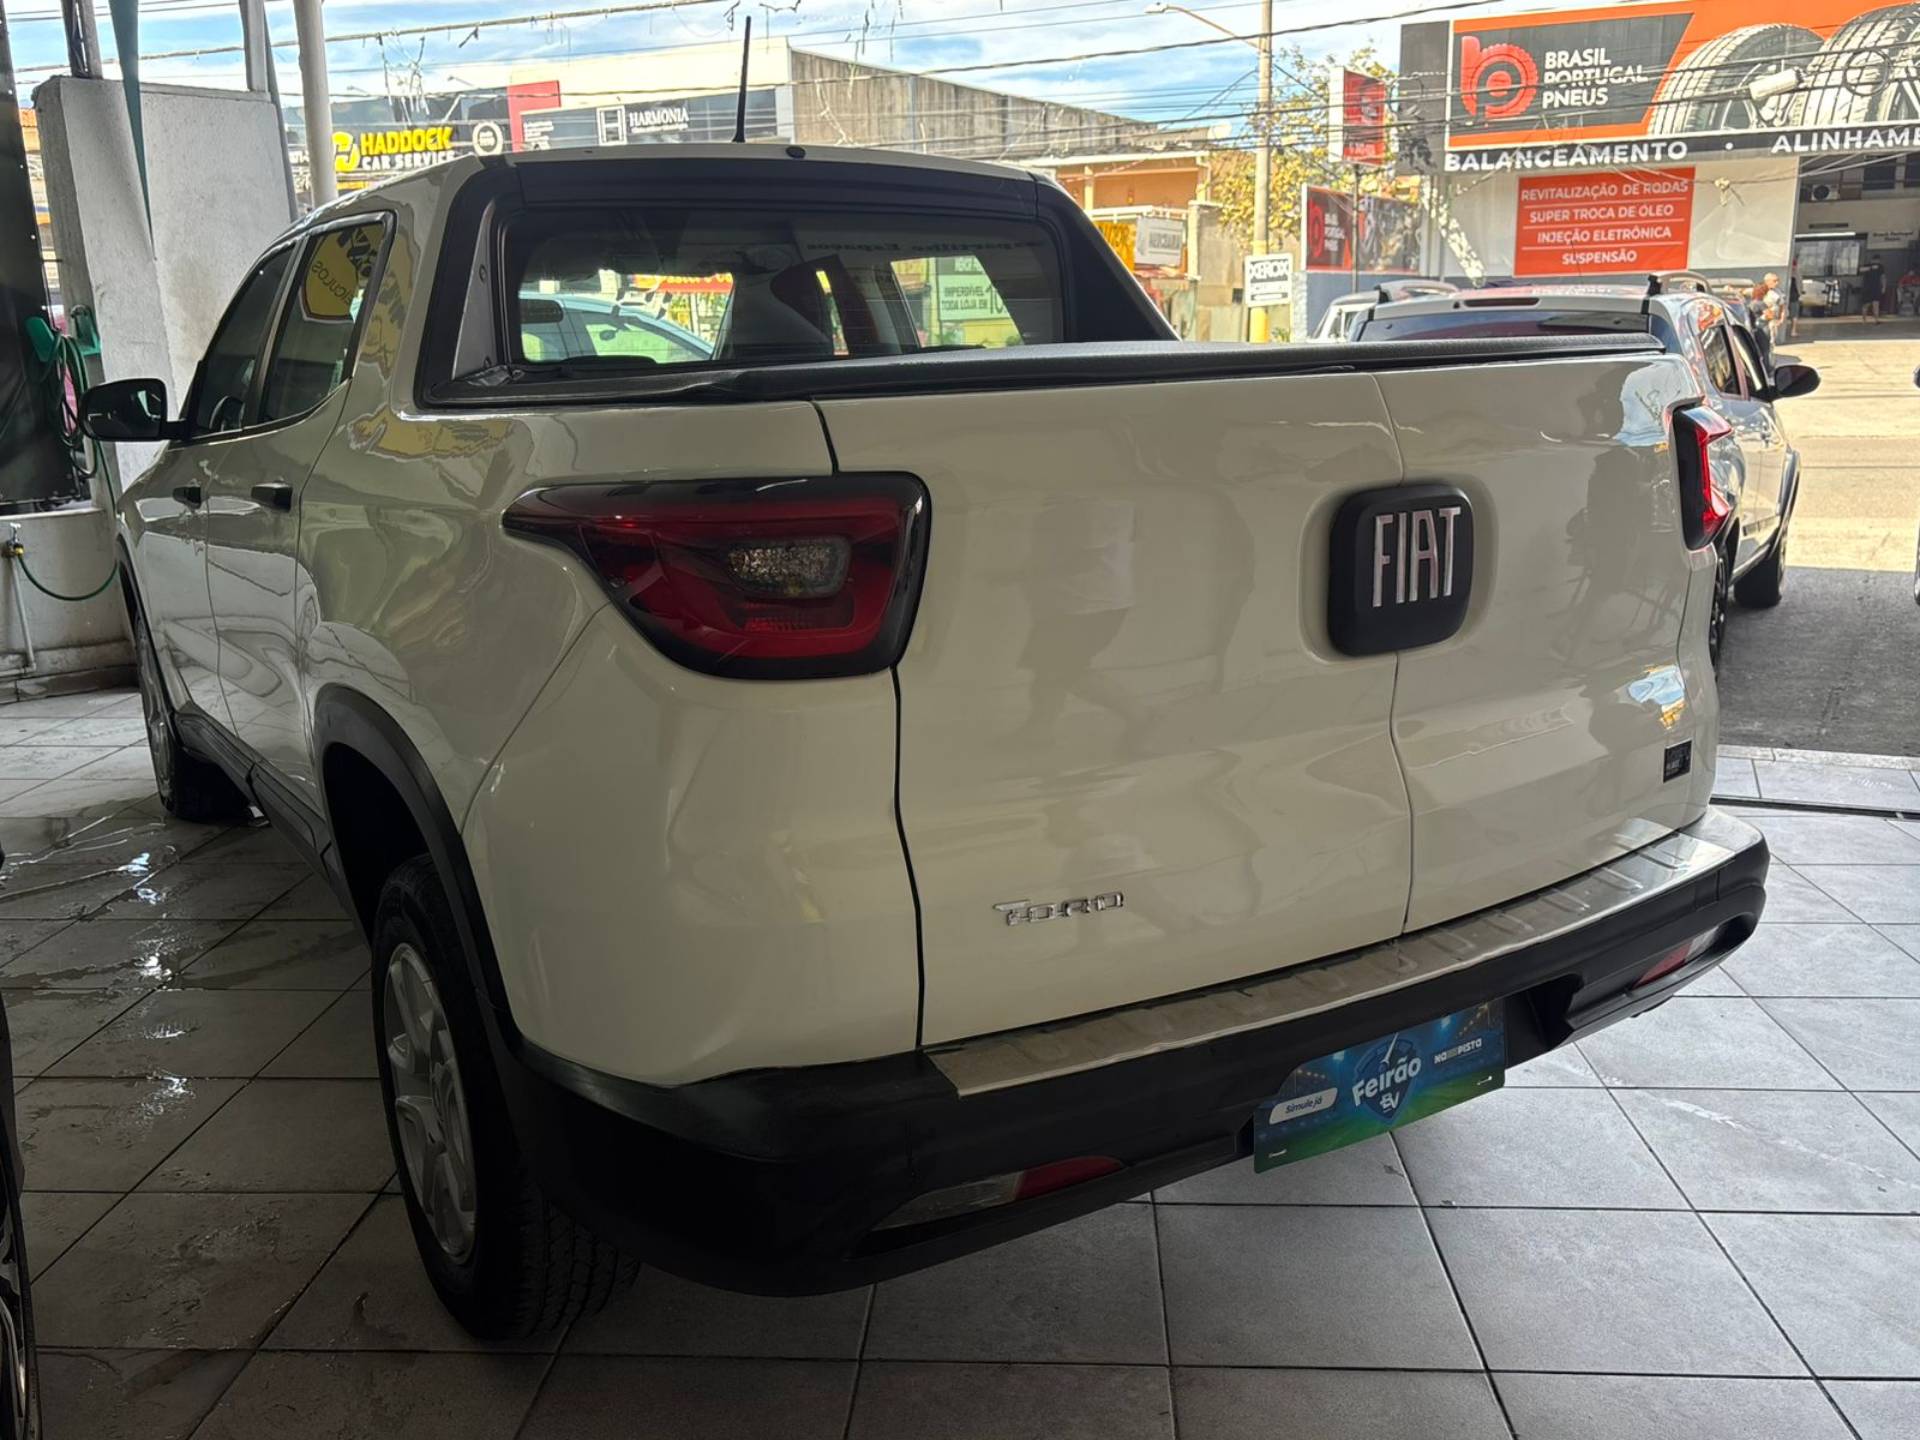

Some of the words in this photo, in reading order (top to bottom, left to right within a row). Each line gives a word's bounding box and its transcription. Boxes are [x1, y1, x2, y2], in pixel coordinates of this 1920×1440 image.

[1545, 48, 1611, 69] BRASIL
[1543, 65, 1648, 87] PORTUGAL
[1542, 87, 1608, 109] PNEUS
[629, 107, 690, 128] HARMONIA
[360, 126, 453, 155] HADDOCK
[362, 154, 390, 170] CAR
[395, 151, 456, 169] SERVICE
[1444, 141, 1688, 172] BALANCEAMENTO
[1521, 182, 1618, 201] REVITALIZAÇÃO
[1622, 182, 1640, 196] DE
[1643, 180, 1689, 194] RODAS
[1530, 209, 1570, 224] SUPER
[1573, 206, 1615, 221] TROCA
[1618, 206, 1637, 218] DE
[1638, 202, 1674, 217] ÓLEO
[1537, 226, 1590, 245] INJEÇÃO
[1592, 225, 1672, 242] ELETRÔNICA
[1562, 249, 1637, 266] SUSPENSÃO
[1249, 259, 1290, 280] XEROX
[1372, 506, 1461, 608] FIAT
[992, 892, 1124, 926] TORO
[1352, 1056, 1422, 1107] Feirão
[1285, 1099, 1313, 1114] Simule
[1312, 1096, 1323, 1109] já
